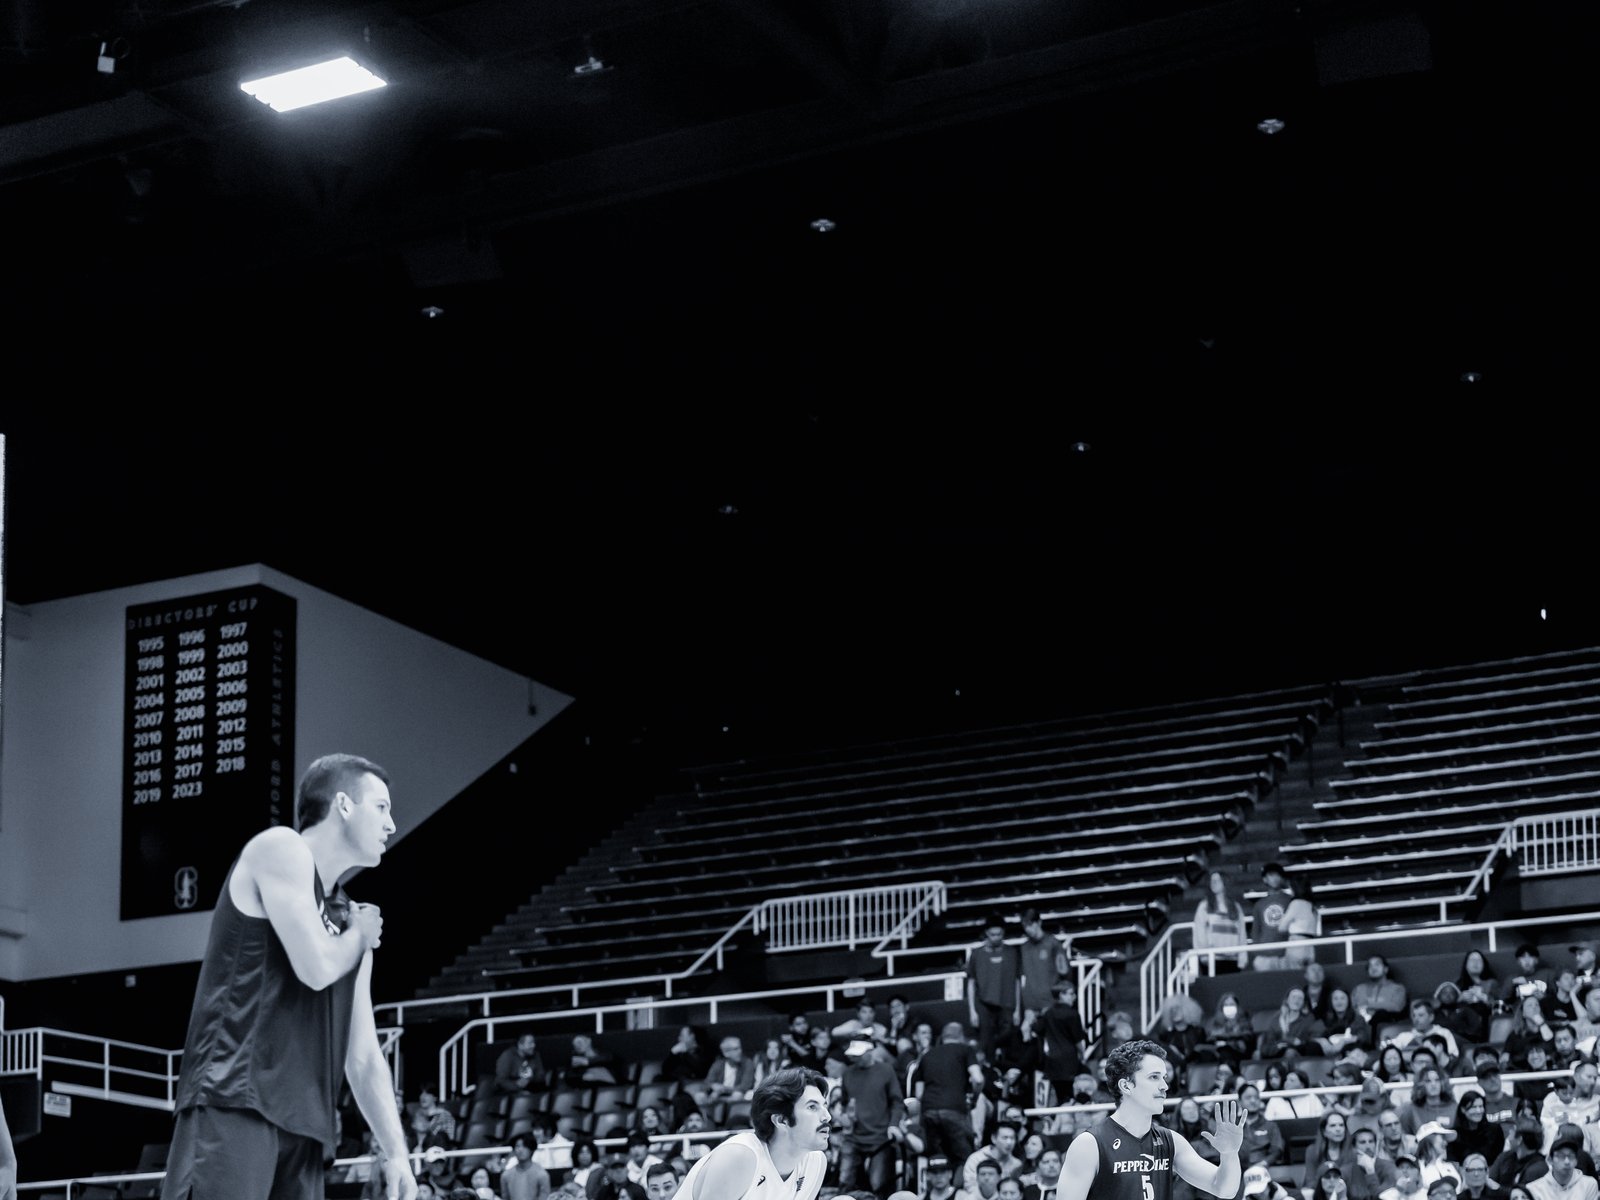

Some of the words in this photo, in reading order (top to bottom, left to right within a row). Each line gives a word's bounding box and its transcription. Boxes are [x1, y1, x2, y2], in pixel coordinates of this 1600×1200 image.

[227, 597, 258, 612] CUP
[177, 629, 205, 646] 1996
[219, 622, 247, 639] 1997
[137, 636, 164, 651] 1995
[216, 641, 249, 659] 2000
[136, 655, 164, 671] 1998
[176, 648, 205, 665] 1999
[174, 666, 206, 685] 2002
[215, 659, 248, 678] 2003
[135, 674, 164, 691] 2001
[215, 678, 248, 697] 2006
[133, 692, 164, 710] 2004
[173, 685, 205, 704] 2005
[173, 704, 205, 723] 2008
[215, 698, 247, 717] 2009
[133, 711, 164, 729] 2007
[216, 717, 246, 735] 2012
[133, 730, 162, 748] 2010
[175, 724, 204, 741] 2011
[173, 743, 203, 761] 2014
[215, 736, 246, 755] 2015
[133, 749, 162, 766] 2013
[215, 756, 245, 774] 2018
[133, 768, 162, 785] 2016
[173, 762, 203, 780] 2017
[133, 787, 161, 804] 2019
[171, 781, 202, 799] 2023
[1113, 1153, 1170, 1174] PEPPERDINE
